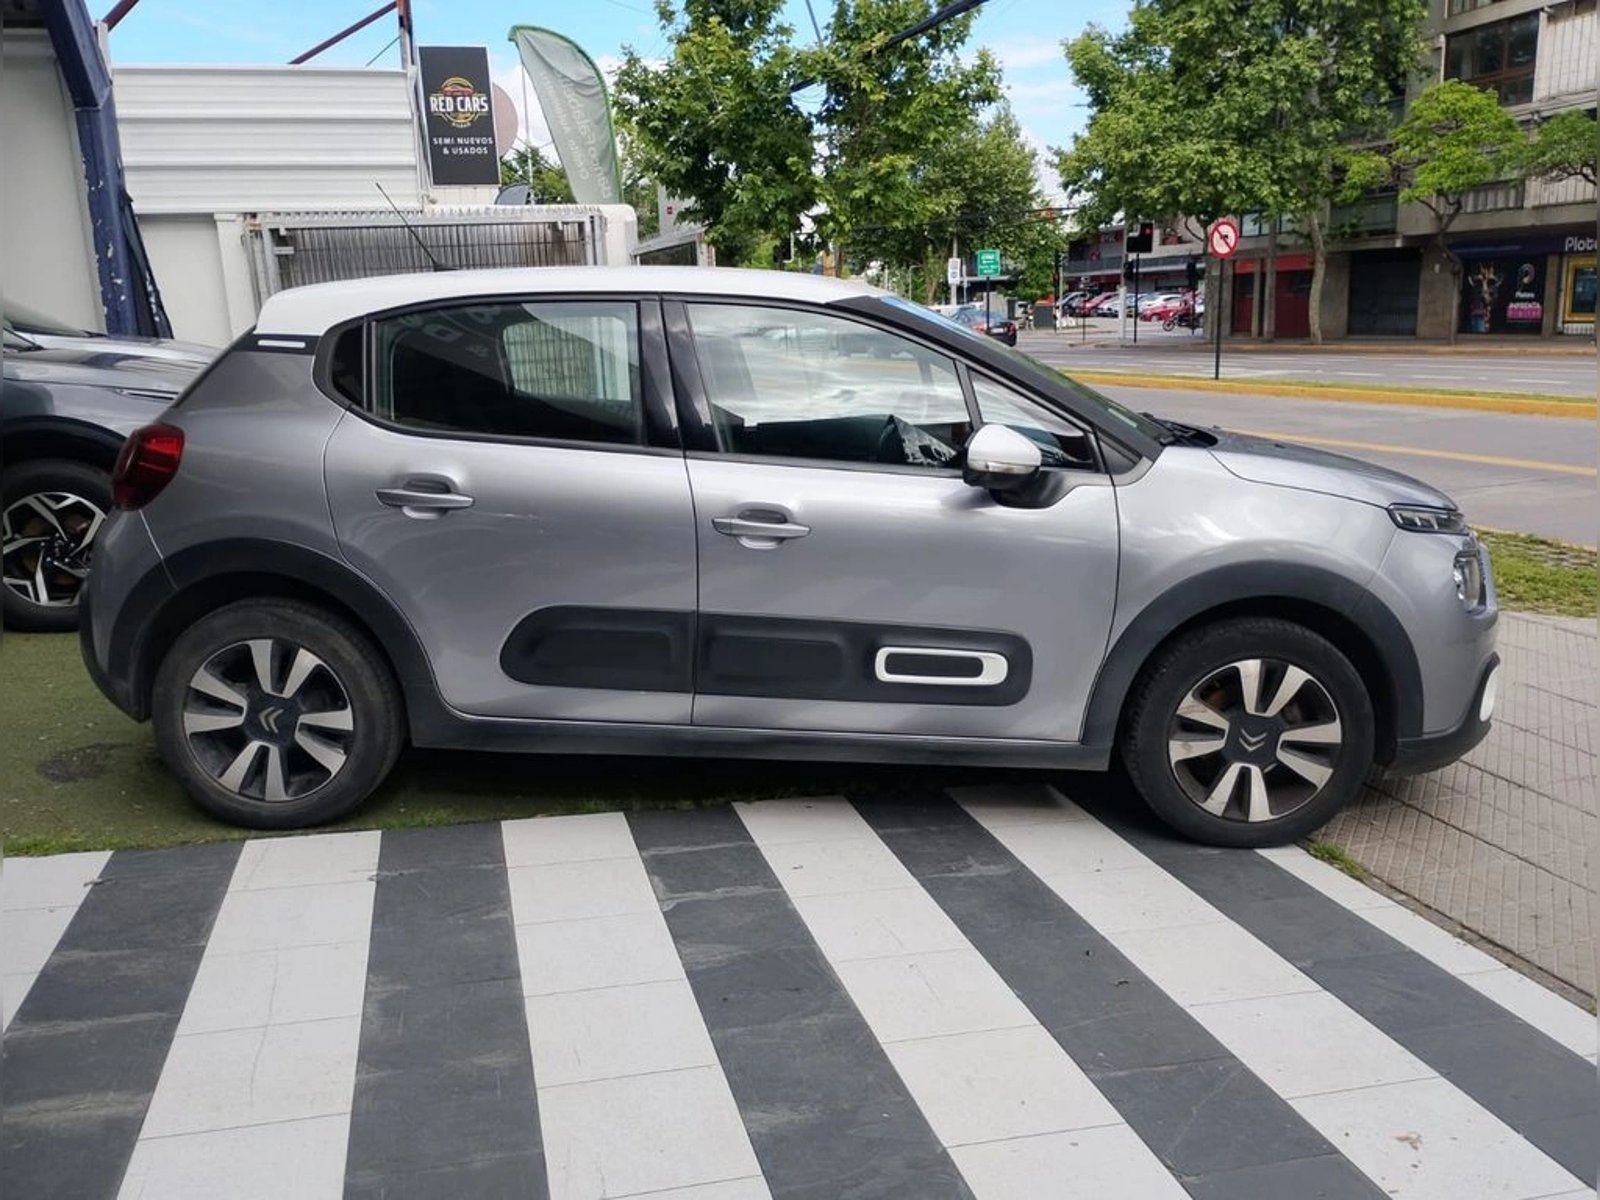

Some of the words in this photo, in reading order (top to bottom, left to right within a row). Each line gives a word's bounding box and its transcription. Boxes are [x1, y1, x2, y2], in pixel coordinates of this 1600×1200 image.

[429, 96, 454, 112] RED
[456, 96, 488, 112] CARS
[432, 137, 454, 145] SEMI
[457, 137, 493, 145] NUEVOS
[443, 147, 449, 155] &
[451, 147, 488, 155] USADOS
